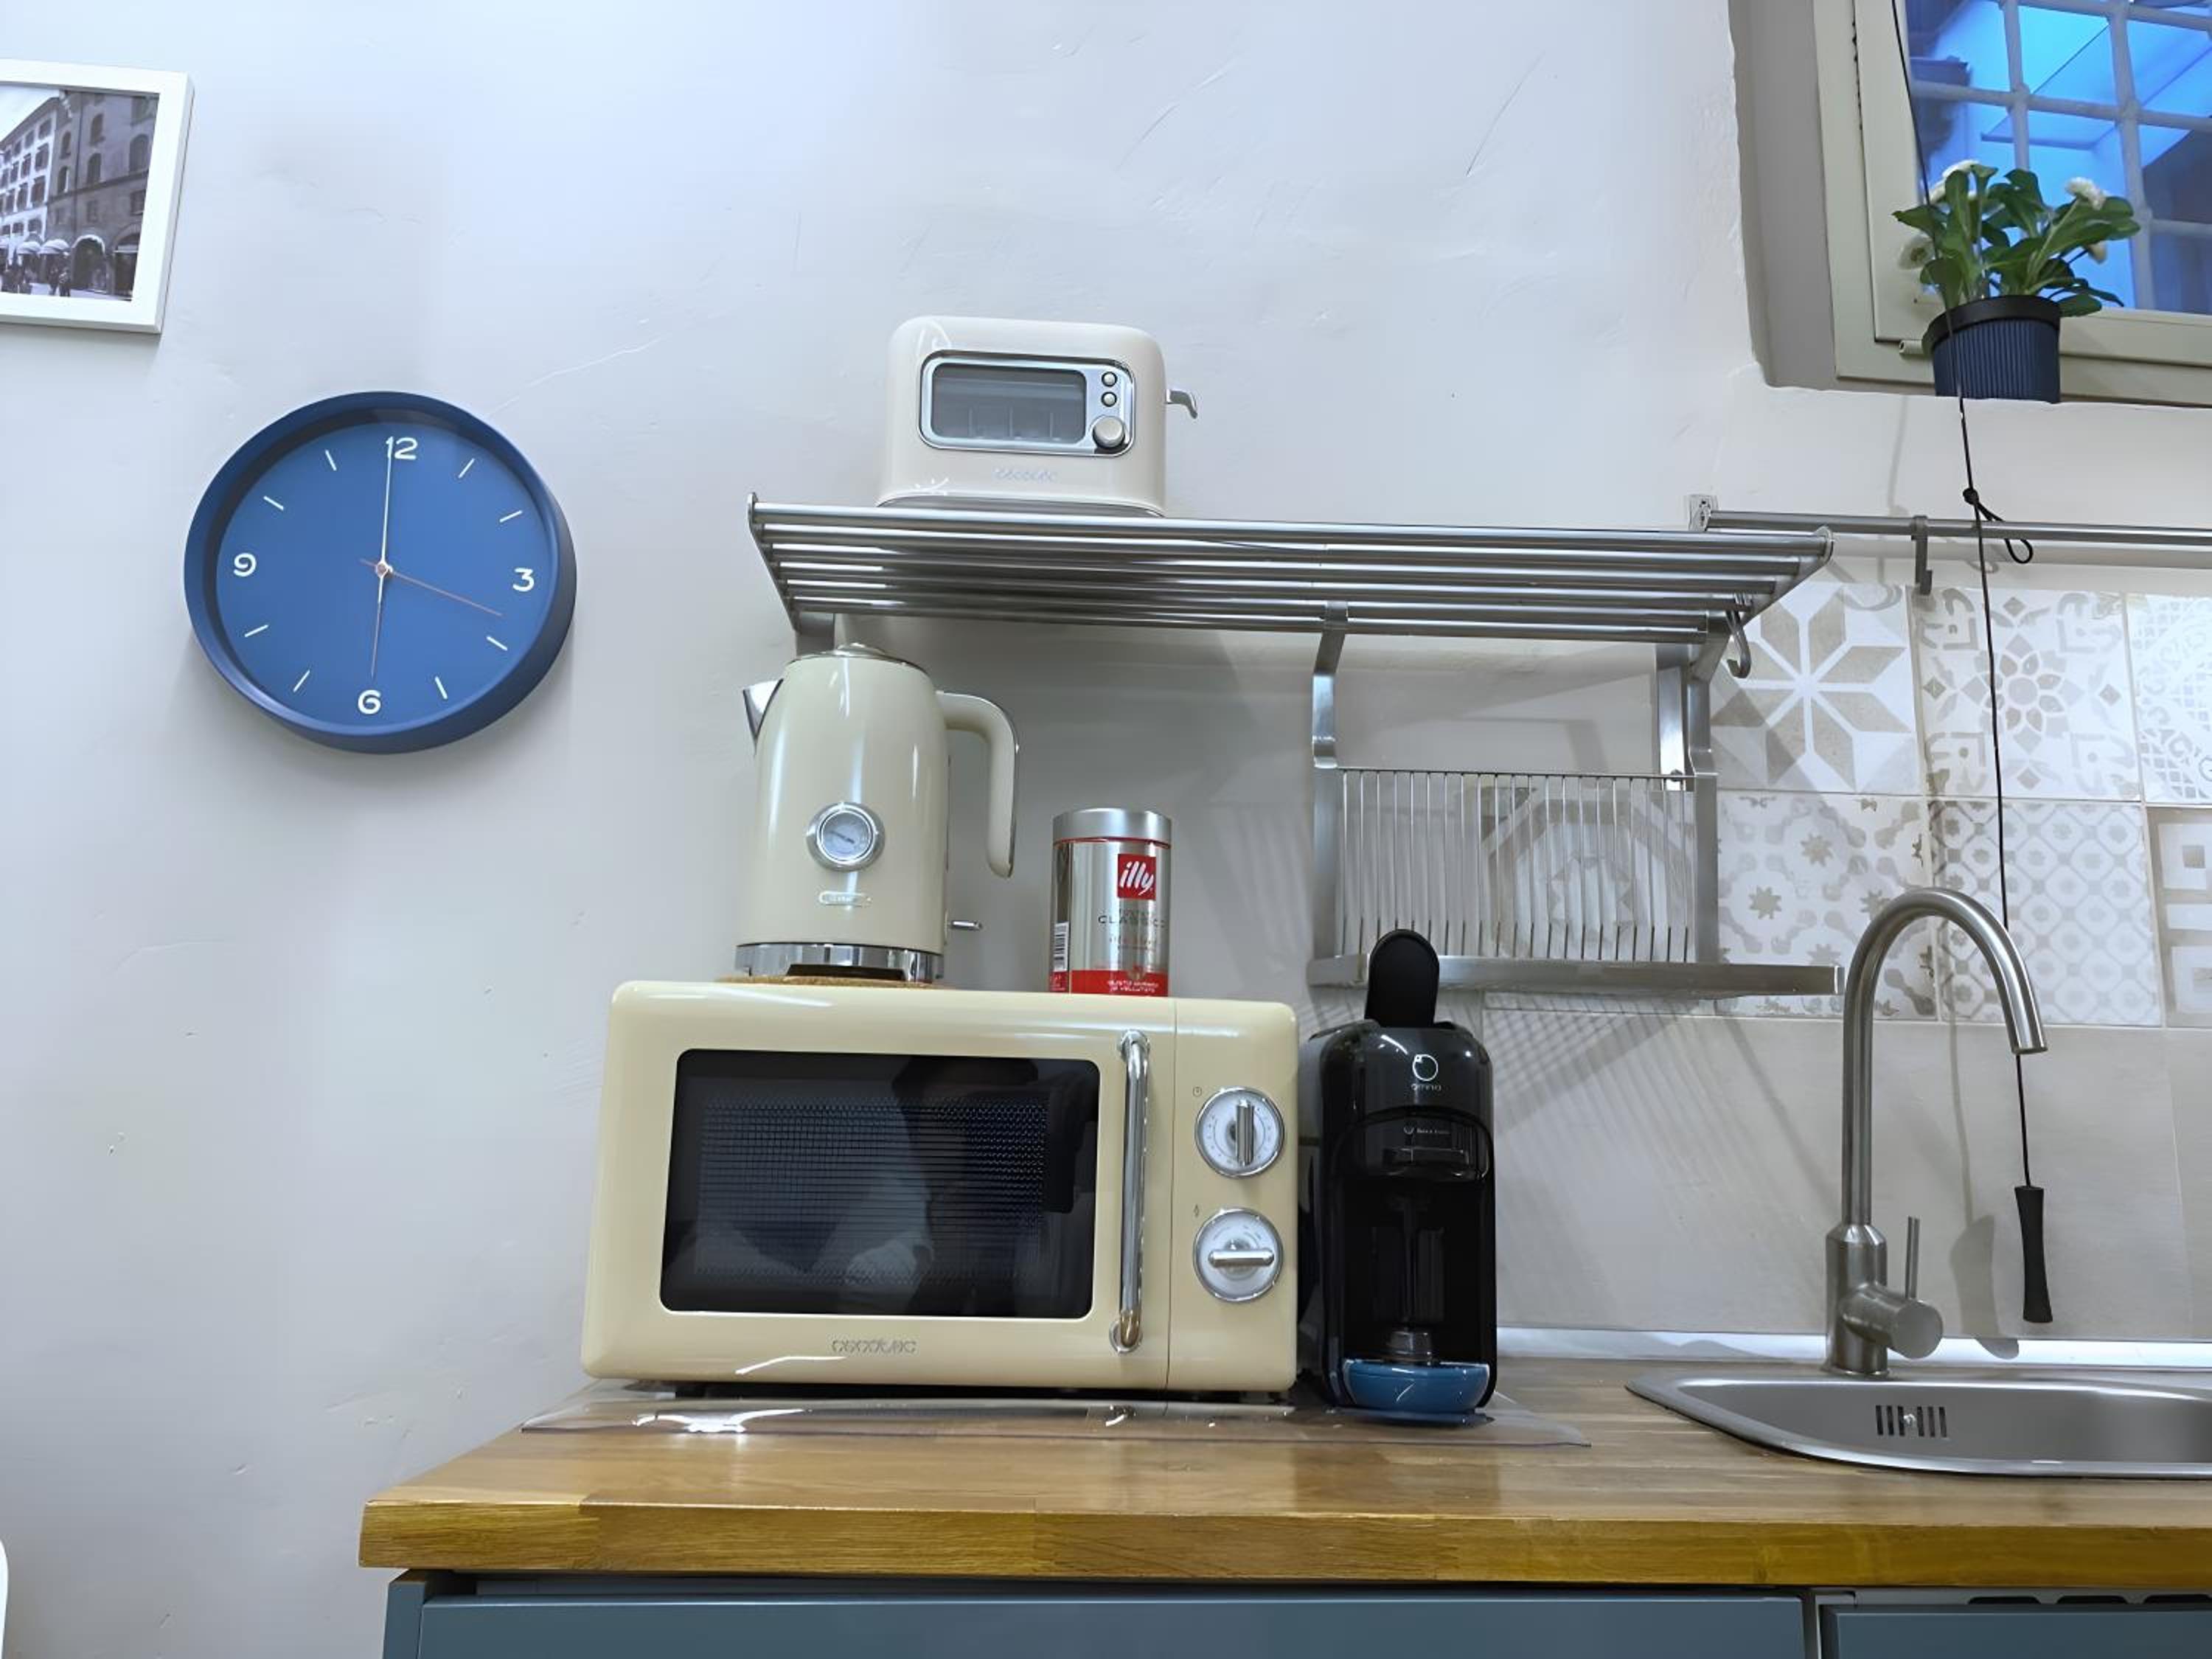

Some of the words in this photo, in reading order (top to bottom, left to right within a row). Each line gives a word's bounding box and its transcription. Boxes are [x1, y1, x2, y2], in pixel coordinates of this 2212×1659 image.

[386, 437, 418, 460] 12
[233, 553, 257, 577] 9
[512, 568, 535, 592] 3
[357, 690, 381, 714] 6
[1119, 860, 1154, 896] illy
